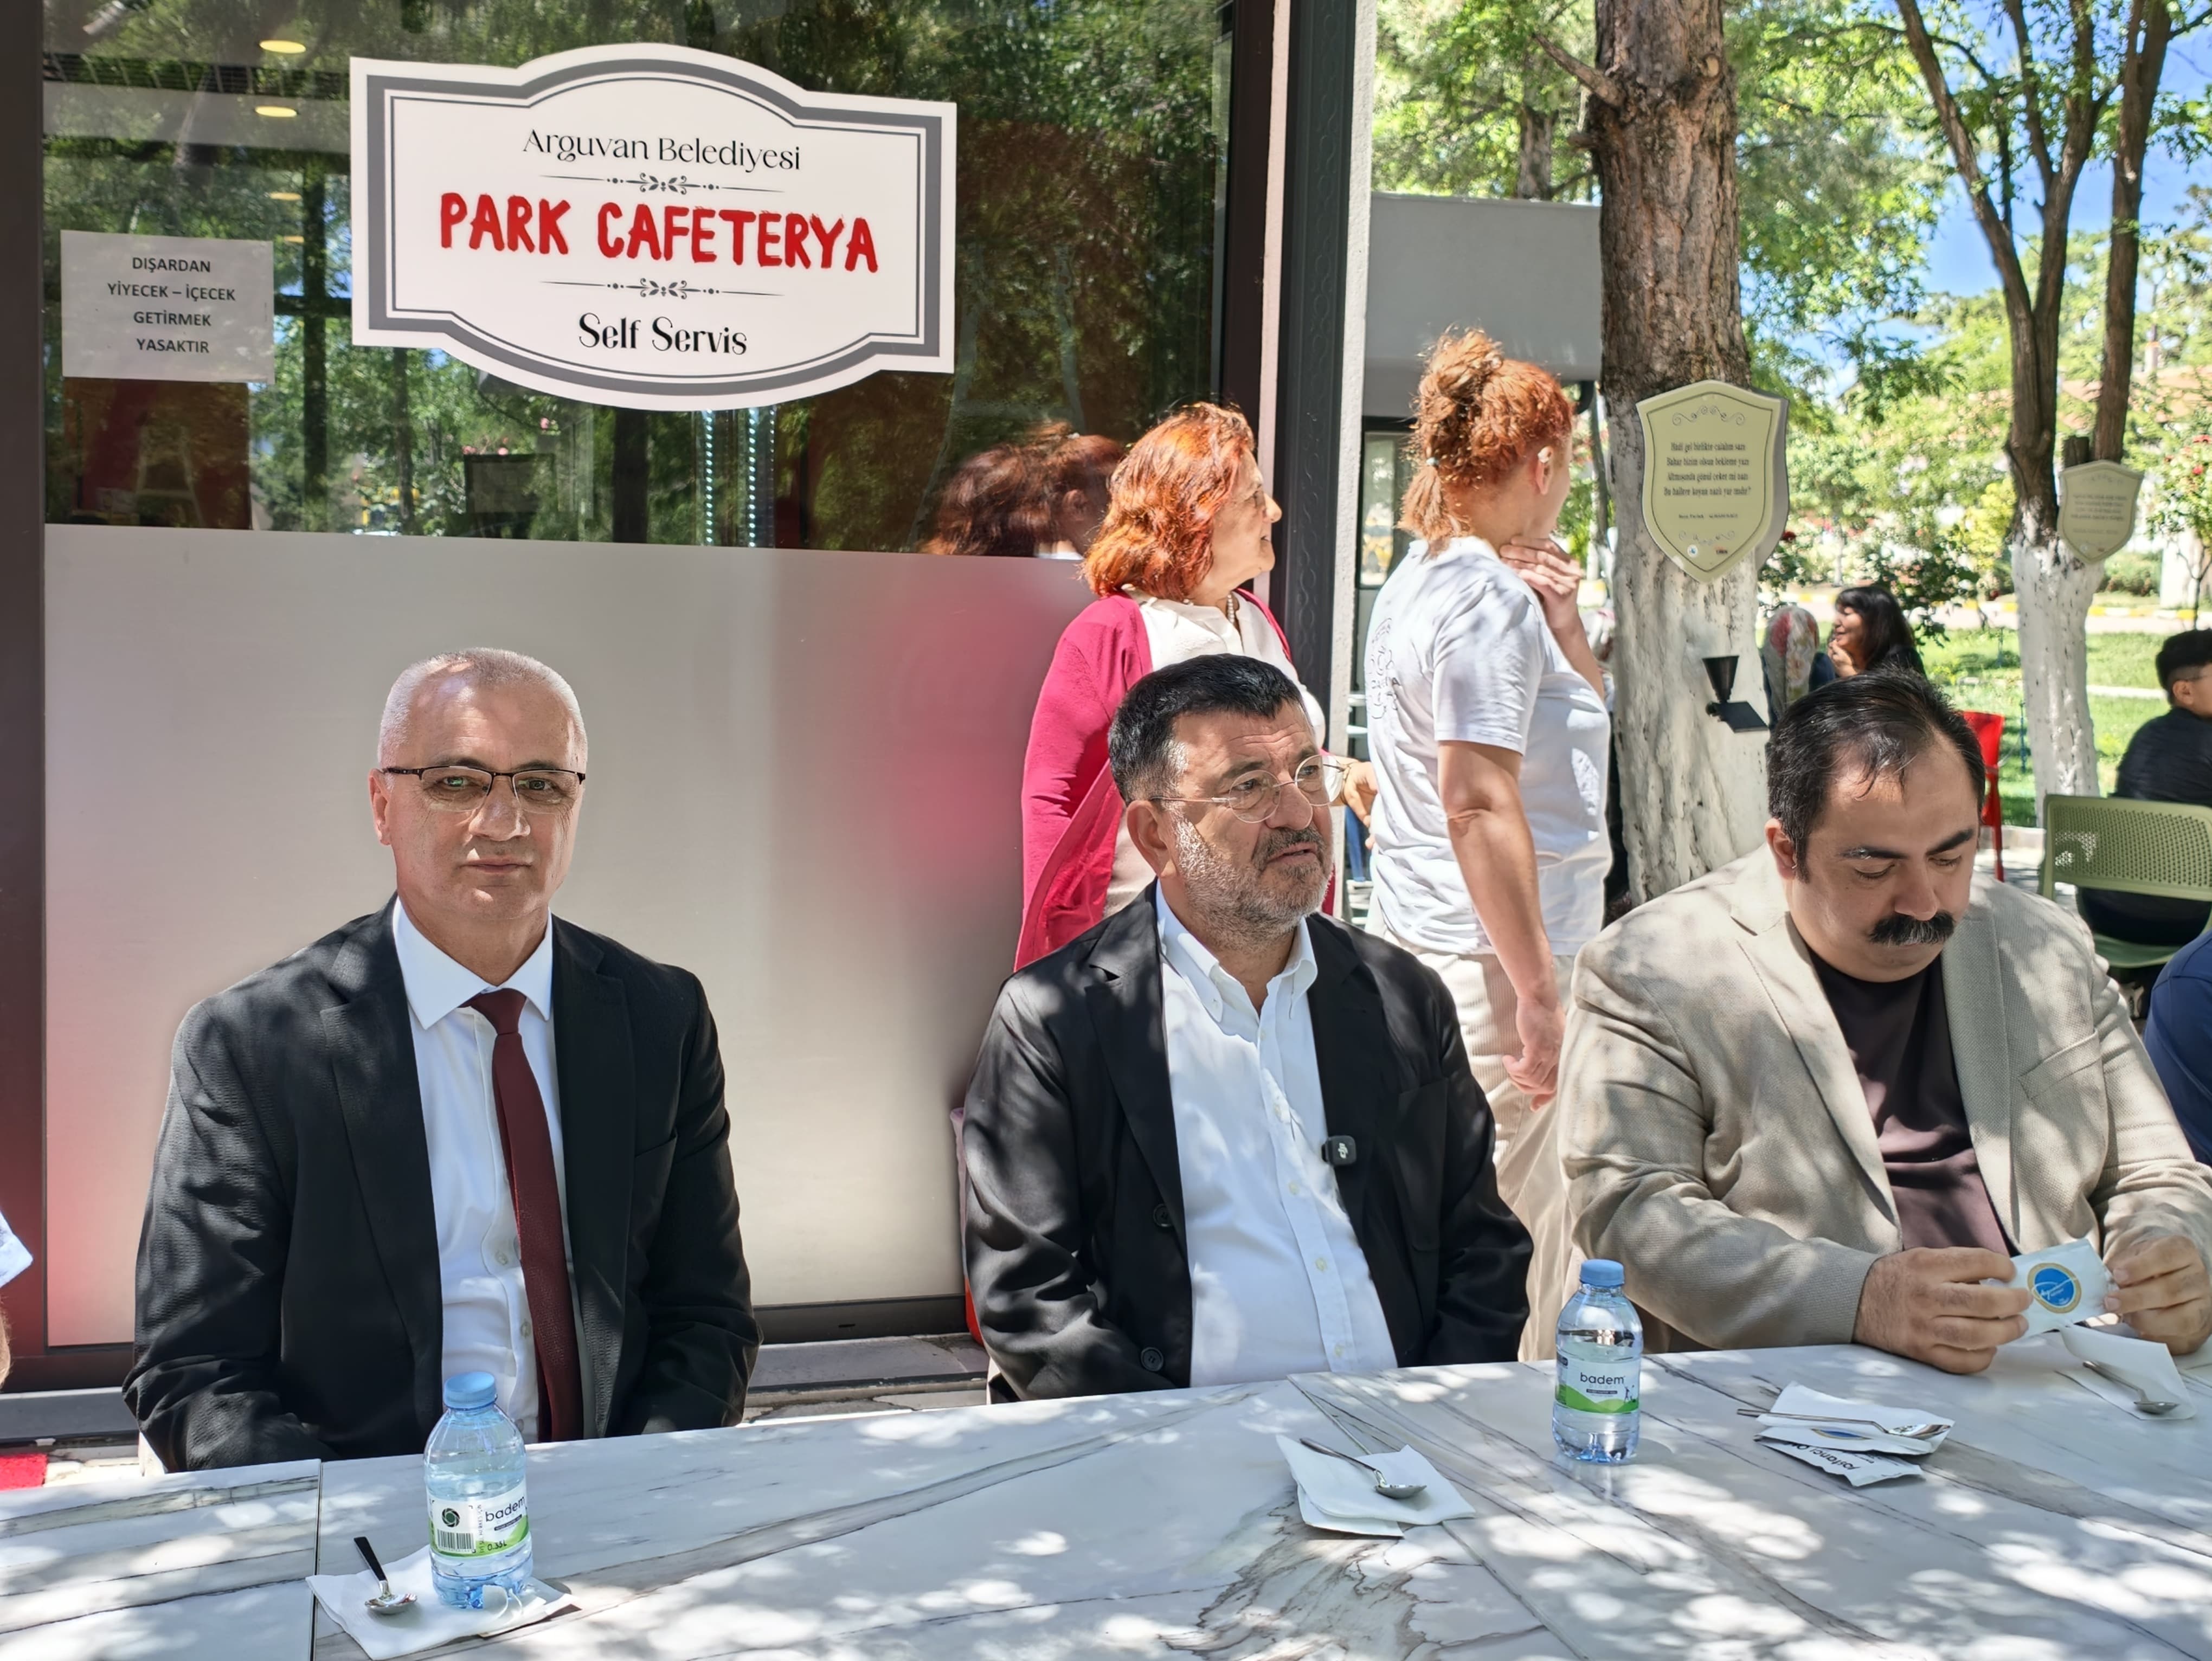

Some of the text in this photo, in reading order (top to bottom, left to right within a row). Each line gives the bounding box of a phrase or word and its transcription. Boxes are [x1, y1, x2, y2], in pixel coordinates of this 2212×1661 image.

[523, 129, 800, 173] Arguvan Belediyesi
[440, 192, 878, 273] PARK CAFETERYA
[132, 257, 210, 273] DIŞARDAN
[107, 280, 169, 298] YİYECEK
[186, 284, 235, 302] İÇECEK
[133, 310, 211, 326] GETİRMEK
[579, 312, 747, 355] Self Servis
[136, 338, 209, 353] YASAKTIR
[1580, 1372, 1624, 1385] badem
[485, 1496, 525, 1522] badem
